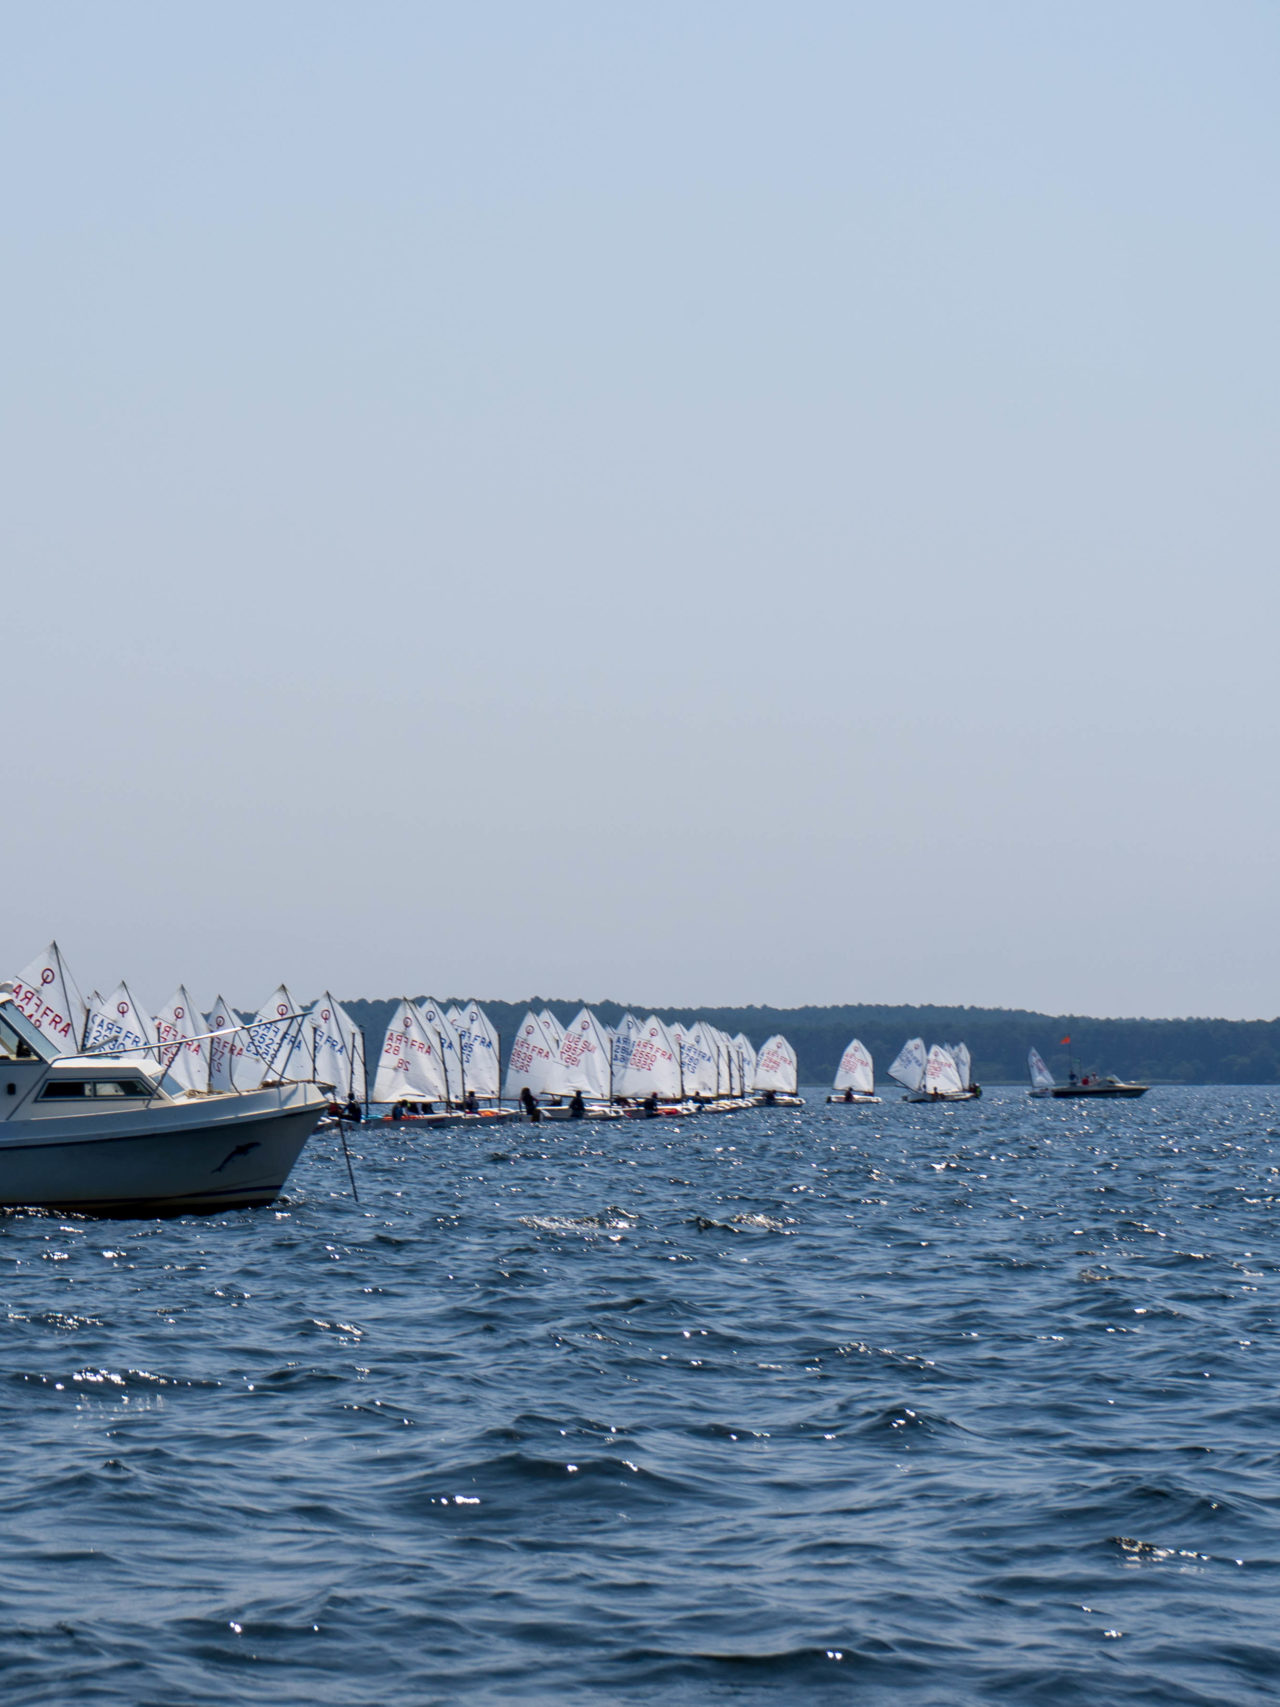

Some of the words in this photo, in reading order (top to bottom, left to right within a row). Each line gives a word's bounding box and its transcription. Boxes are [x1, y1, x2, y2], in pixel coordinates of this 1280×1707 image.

[40, 1006, 72, 1038] FRA
[222, 1040, 244, 1057] FRA
[324, 1035, 345, 1056] FRA
[384, 1043, 401, 1056] 28
[410, 1039, 432, 1056] FRA
[473, 1034, 493, 1049] FRA
[531, 1045, 550, 1060] FRA
[655, 1047, 673, 1061] FRA
